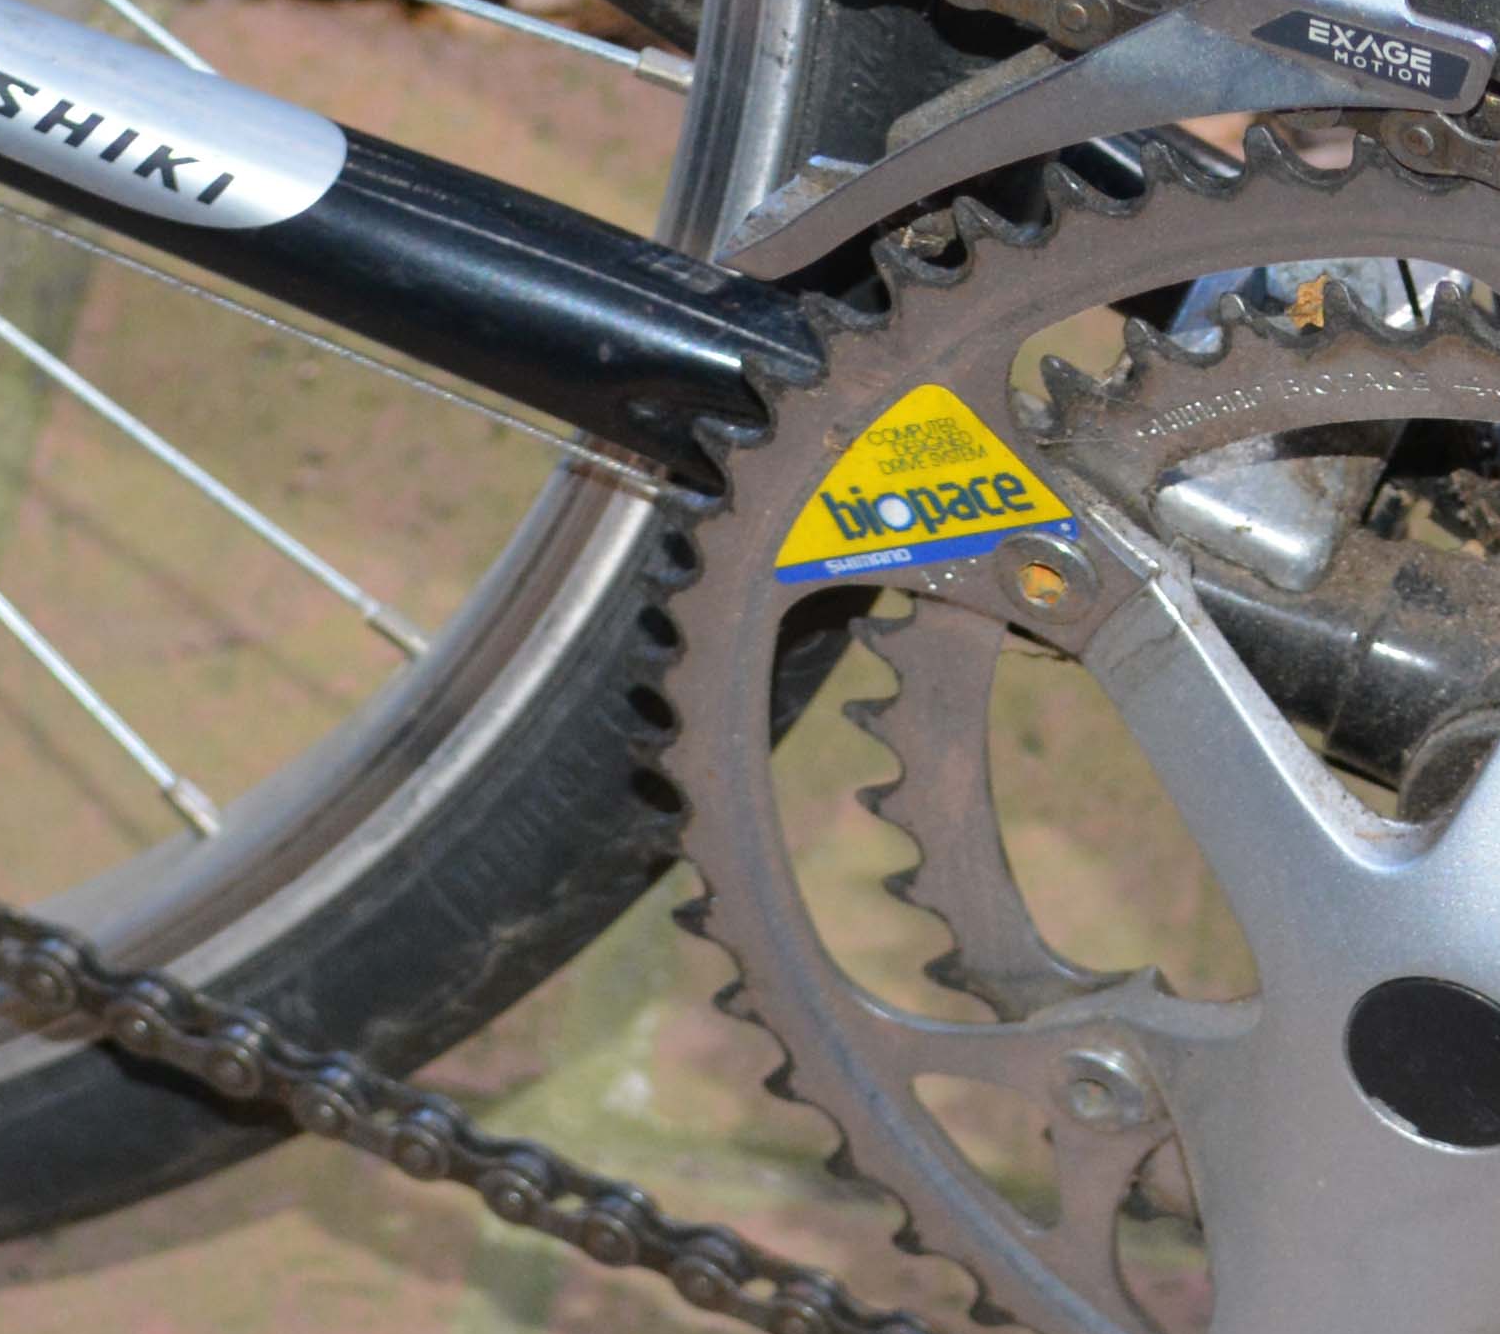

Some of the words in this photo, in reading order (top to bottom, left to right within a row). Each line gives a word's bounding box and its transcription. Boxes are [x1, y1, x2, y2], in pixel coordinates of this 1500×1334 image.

[1309, 19, 1433, 73] EXAGE
[1334, 49, 1432, 87] MOTION
[820, 472, 1035, 540] biopace
[824, 547, 913, 575] SHIMANO
